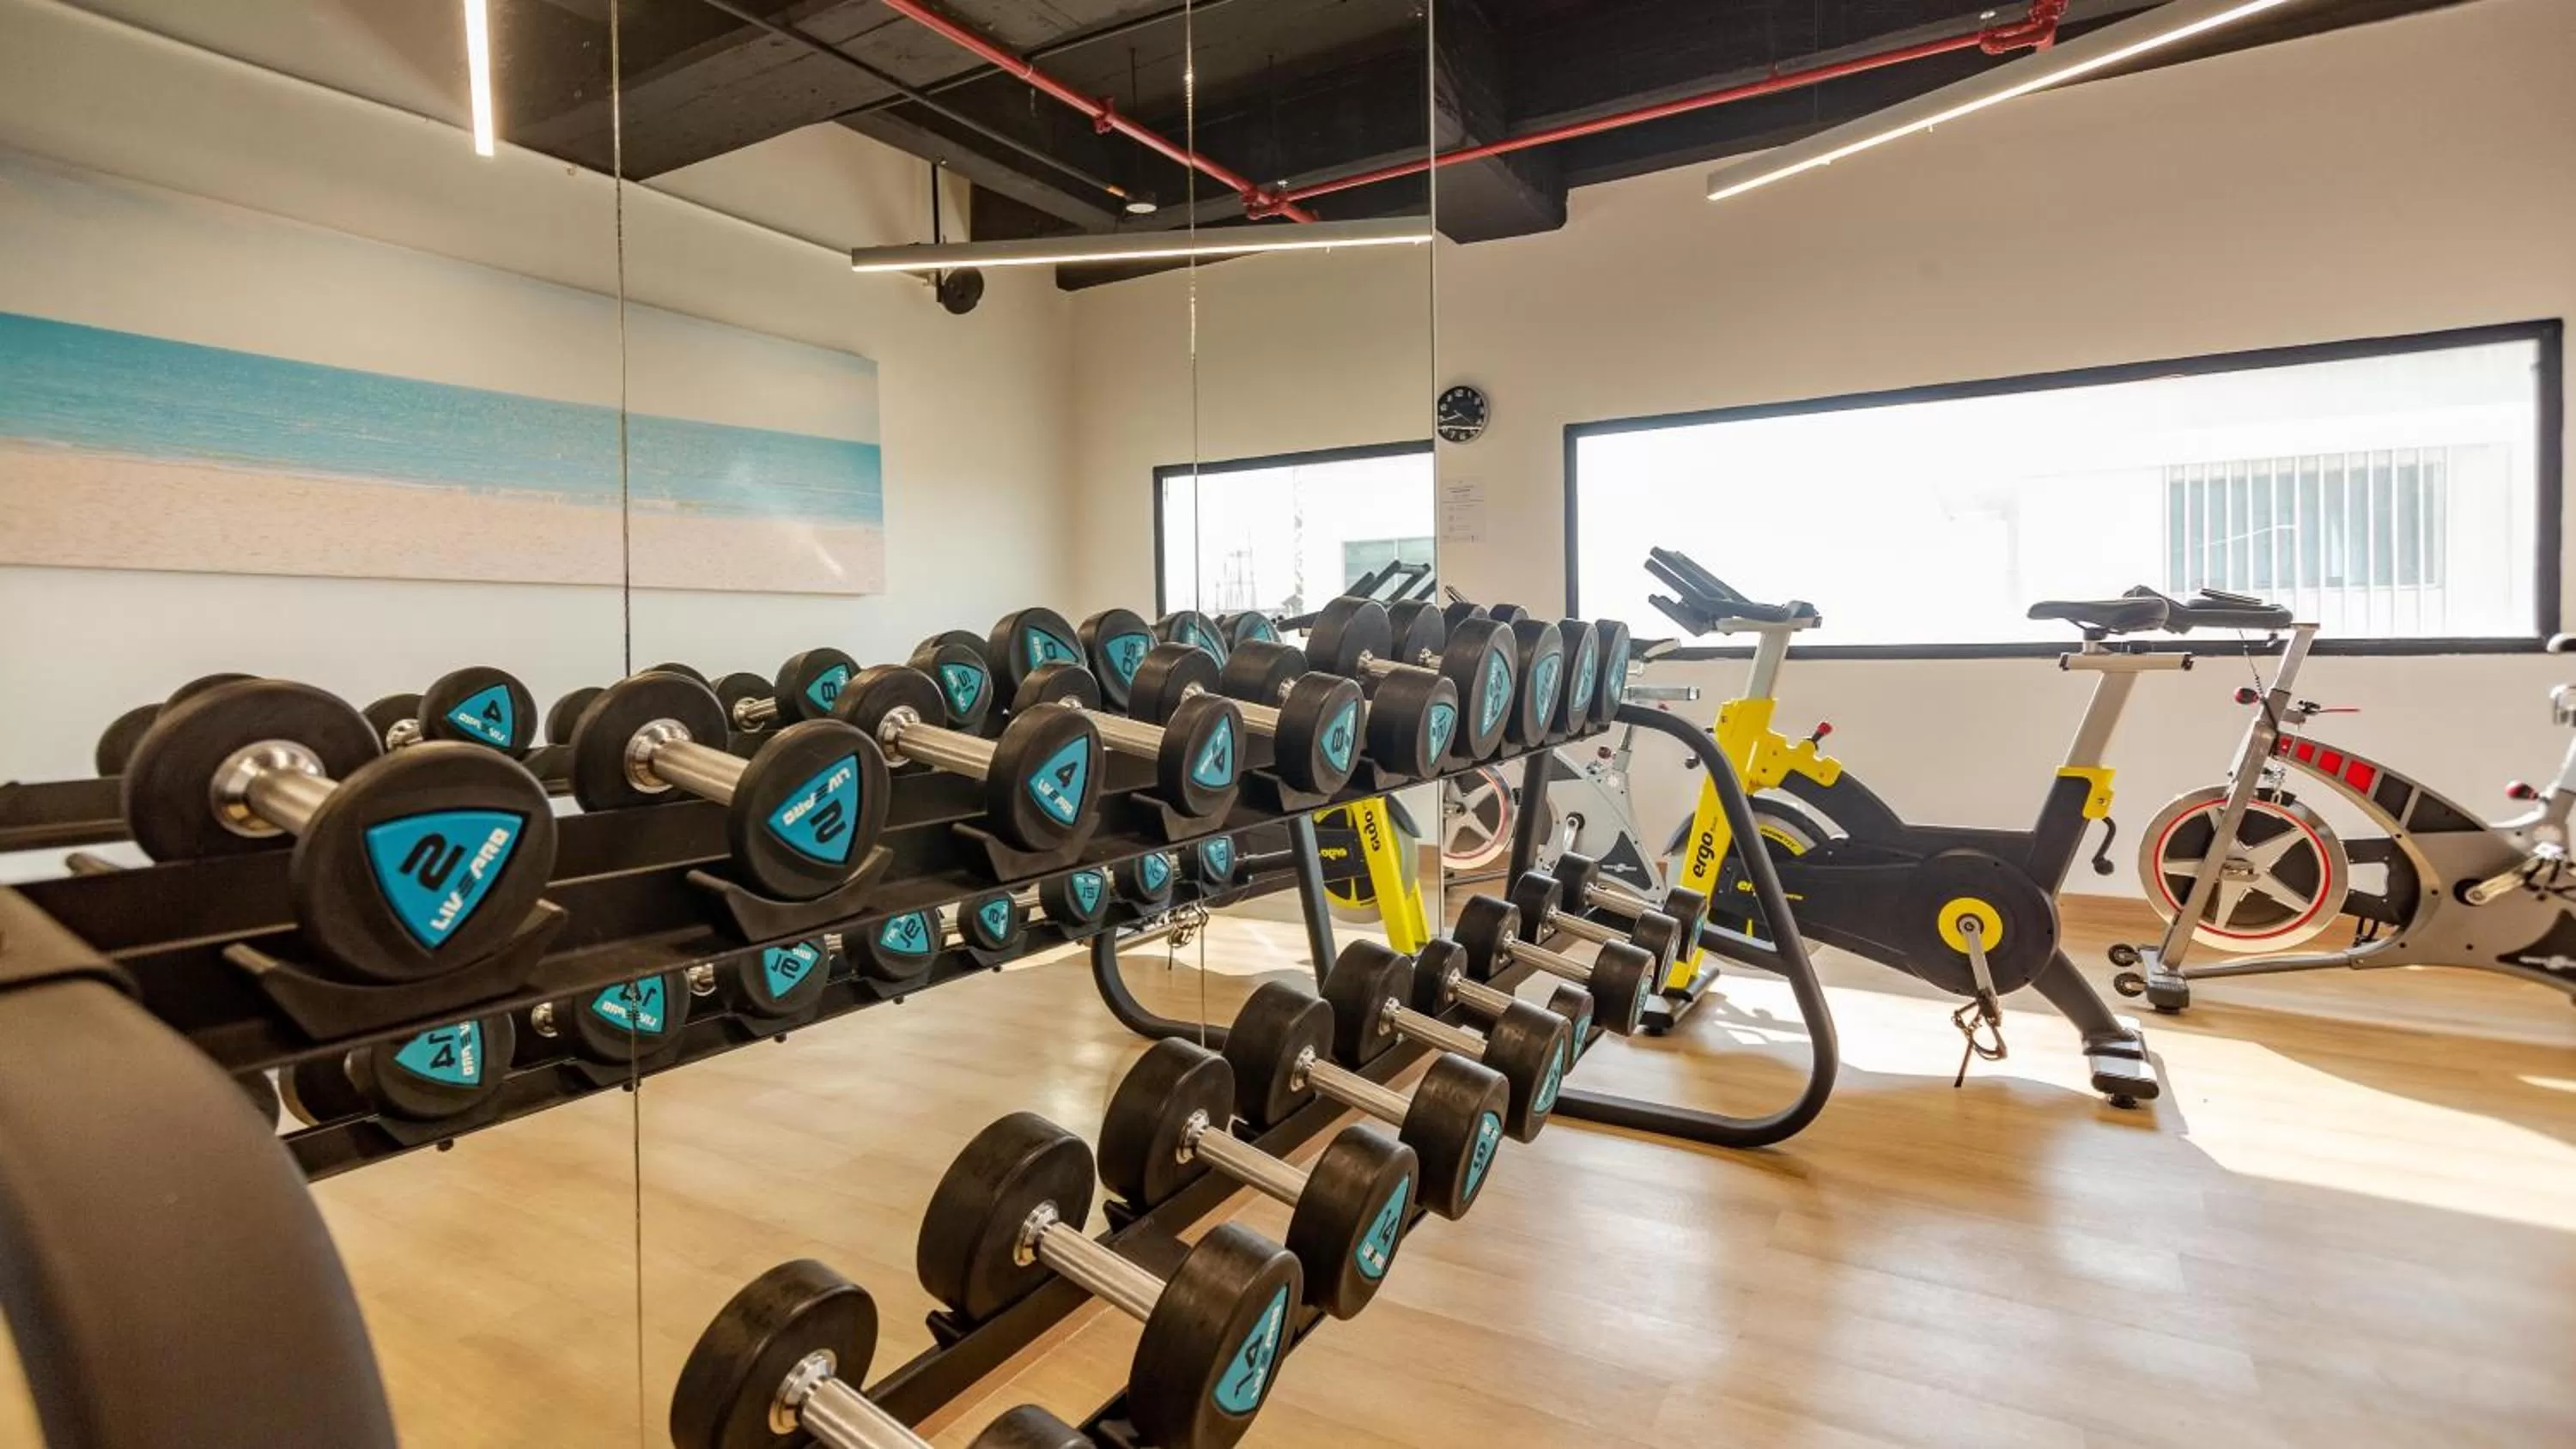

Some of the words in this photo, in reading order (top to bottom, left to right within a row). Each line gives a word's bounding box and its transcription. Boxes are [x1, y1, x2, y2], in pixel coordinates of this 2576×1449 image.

[1054, 761, 1078, 787] 4
[1212, 747, 1225, 774] 4
[782, 767, 850, 827] LIVEPRO
[809, 798, 847, 844] 2
[398, 832, 467, 892] 2
[429, 828, 509, 931] LIVEPRO
[1692, 832, 1715, 878] ergo
[1235, 1334, 1263, 1399] 14
